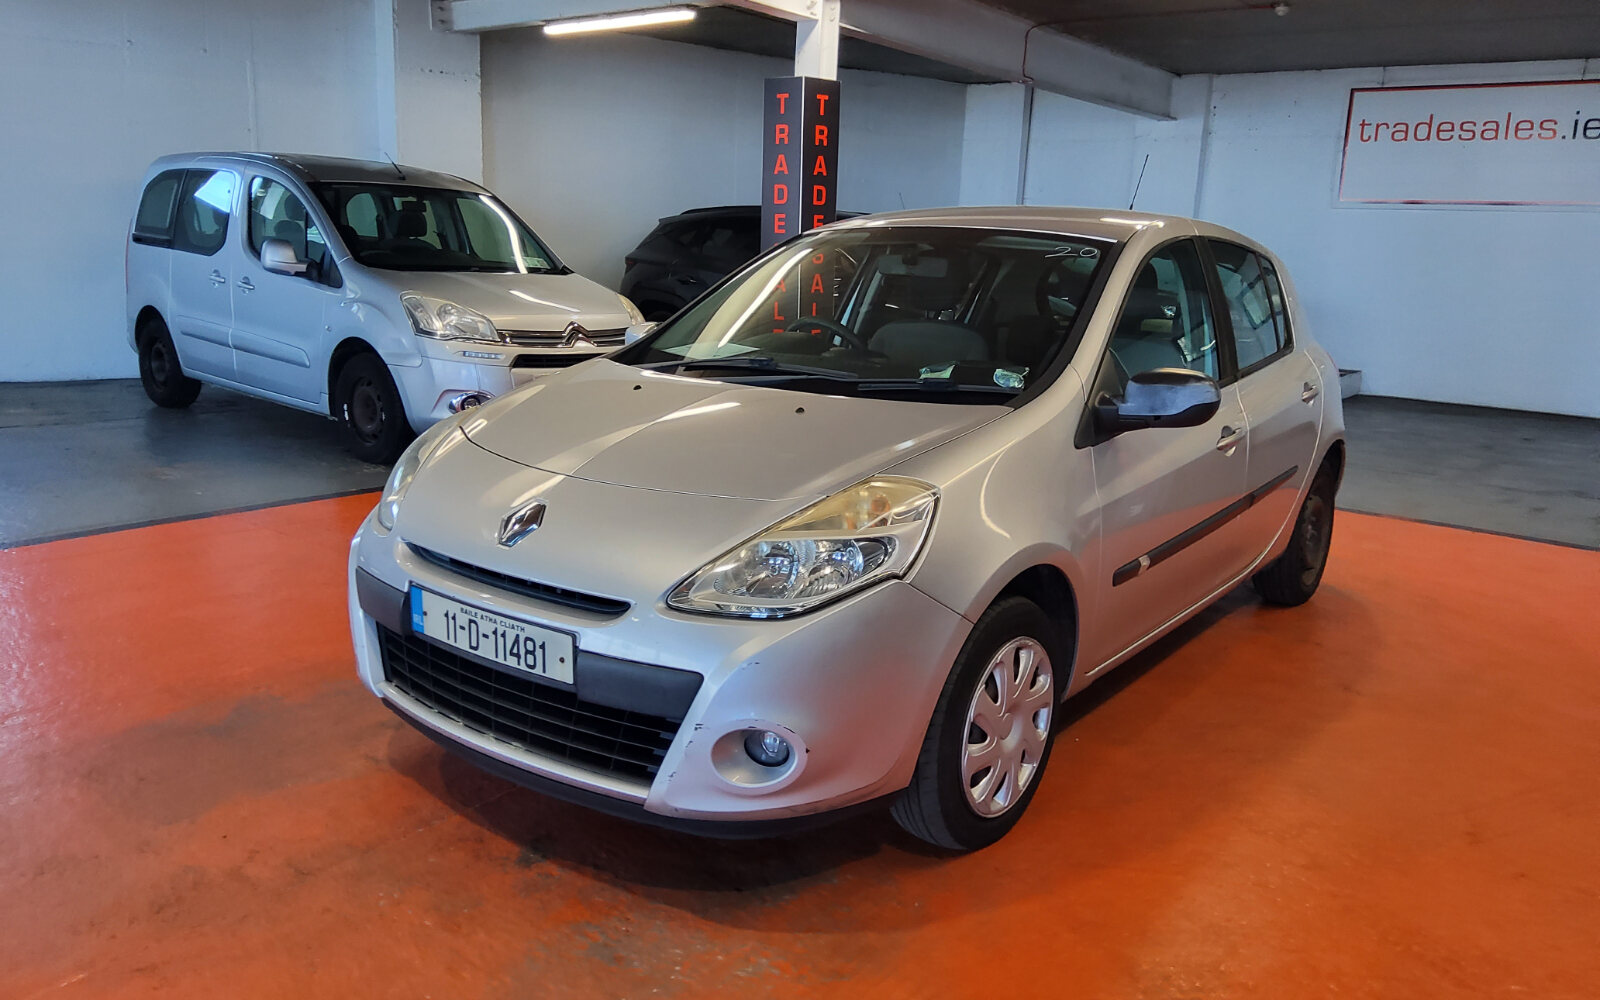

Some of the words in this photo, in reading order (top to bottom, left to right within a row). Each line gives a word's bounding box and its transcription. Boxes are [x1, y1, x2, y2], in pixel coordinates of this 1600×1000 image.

[1358, 110, 1600, 143] tradesales.ie
[773, 93, 790, 234] TRADE
[812, 94, 829, 229] TRADE
[1044, 246, 1098, 258] 20
[444, 609, 547, 674] 11-D-11481
[460, 607, 479, 619] BAILE
[499, 620, 526, 633] CLIATH
